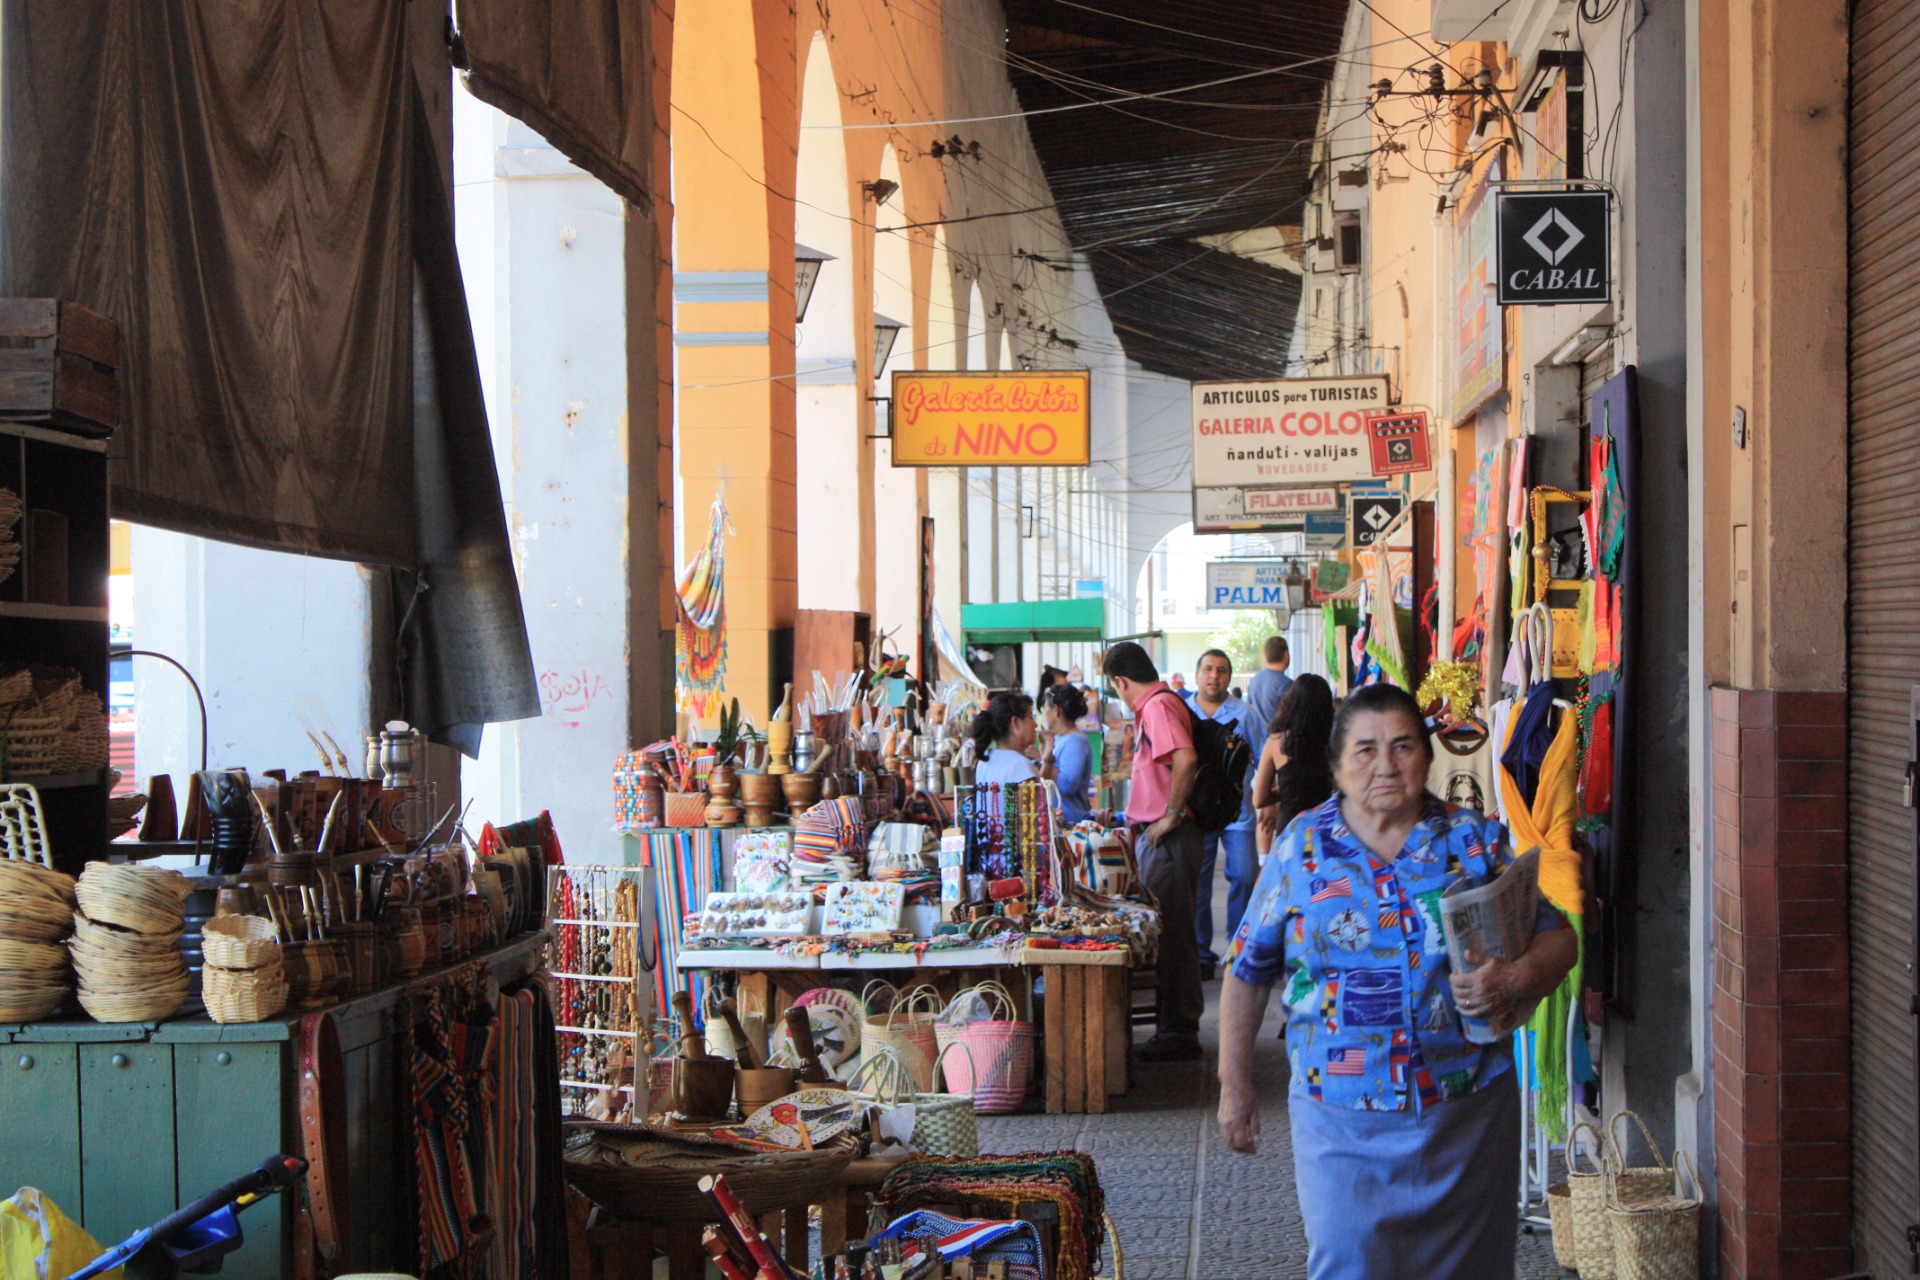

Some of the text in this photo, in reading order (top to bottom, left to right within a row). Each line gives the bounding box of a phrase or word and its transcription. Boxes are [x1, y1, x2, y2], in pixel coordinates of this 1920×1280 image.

[1509, 268, 1600, 290] CABAL
[902, 381, 1080, 425] Galería Colón
[1203, 386, 1378, 405] ARTICULOS para TURISTAS
[1199, 417, 1275, 436] GALERIA
[1376, 418, 1418, 429] PLAN
[1376, 426, 1420, 437] CABAL
[924, 423, 1058, 456] de NINO
[1304, 444, 1359, 461] valijas
[1257, 463, 1329, 475] NOVEDADES
[1249, 492, 1333, 508] FILATELIA
